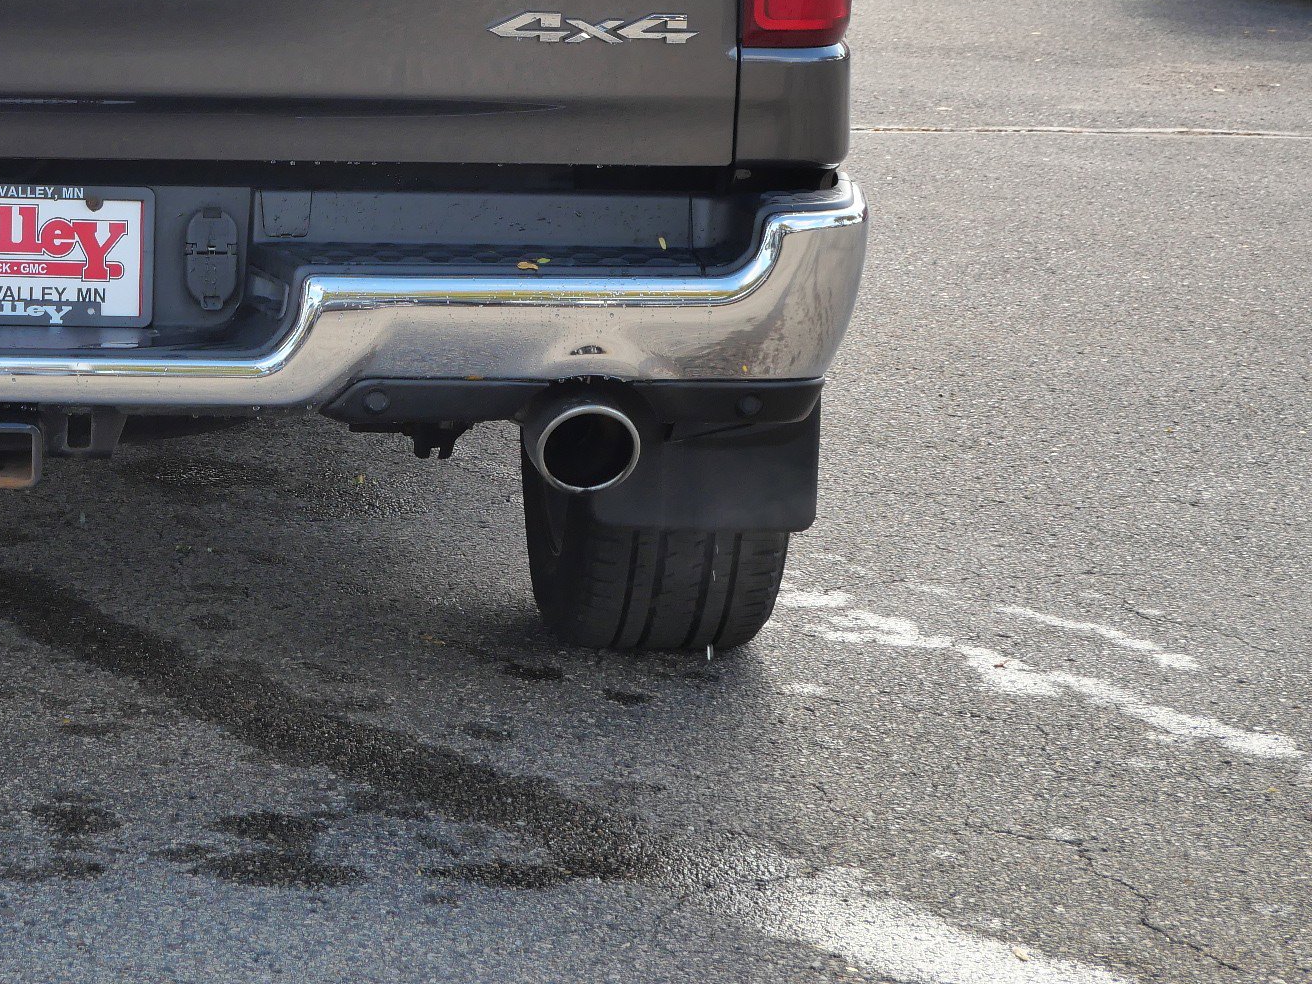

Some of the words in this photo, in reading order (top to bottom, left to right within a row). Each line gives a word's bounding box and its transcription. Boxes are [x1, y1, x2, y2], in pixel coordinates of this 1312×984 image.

[62, 187, 85, 199] MN
[20, 263, 48, 274] GMC
[76, 287, 106, 303] MN
